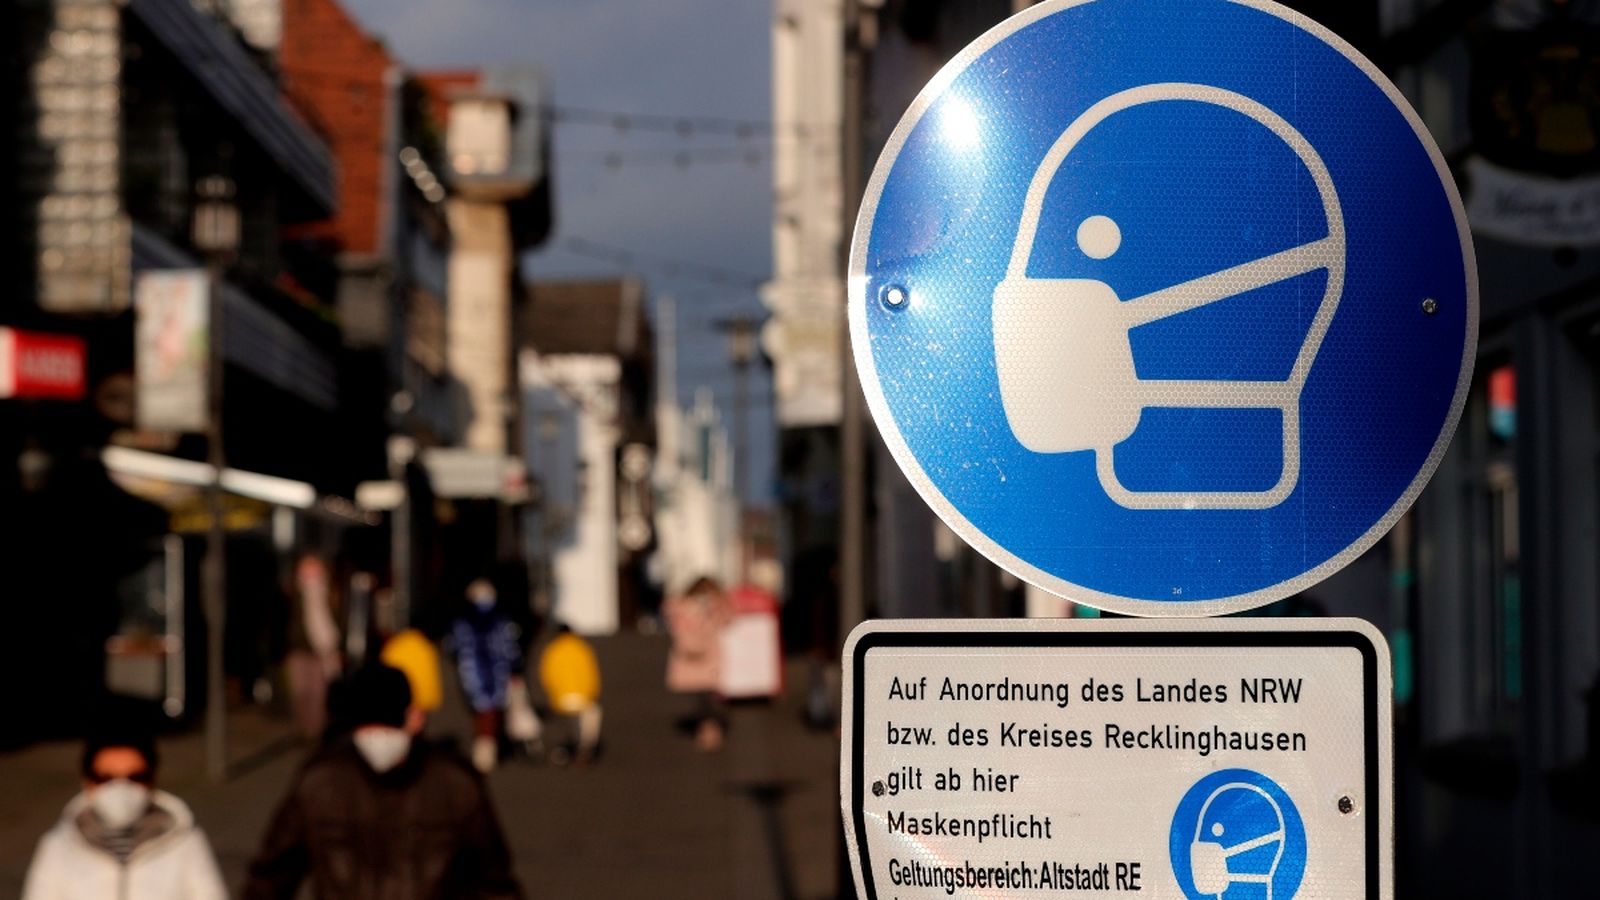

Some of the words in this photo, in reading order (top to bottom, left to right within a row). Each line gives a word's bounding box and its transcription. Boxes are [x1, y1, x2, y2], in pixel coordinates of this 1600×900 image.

[888, 676, 927, 701] Auf
[938, 677, 1070, 709] Anordnung
[1081, 677, 1125, 704] des
[1136, 677, 1228, 704] Landes
[1240, 678, 1304, 705] NRW
[887, 720, 937, 746] bzw.
[947, 722, 989, 747] des
[1000, 722, 1093, 749] Kreises
[1104, 723, 1307, 757] Recklinghausen
[887, 765, 923, 797] gilt
[934, 767, 961, 792] ab
[972, 767, 1020, 793] hier
[887, 810, 1052, 844] Maskenpflicht
[888, 857, 1111, 896] Geltungsbereich:Altstadt
[1115, 861, 1142, 892] RE
